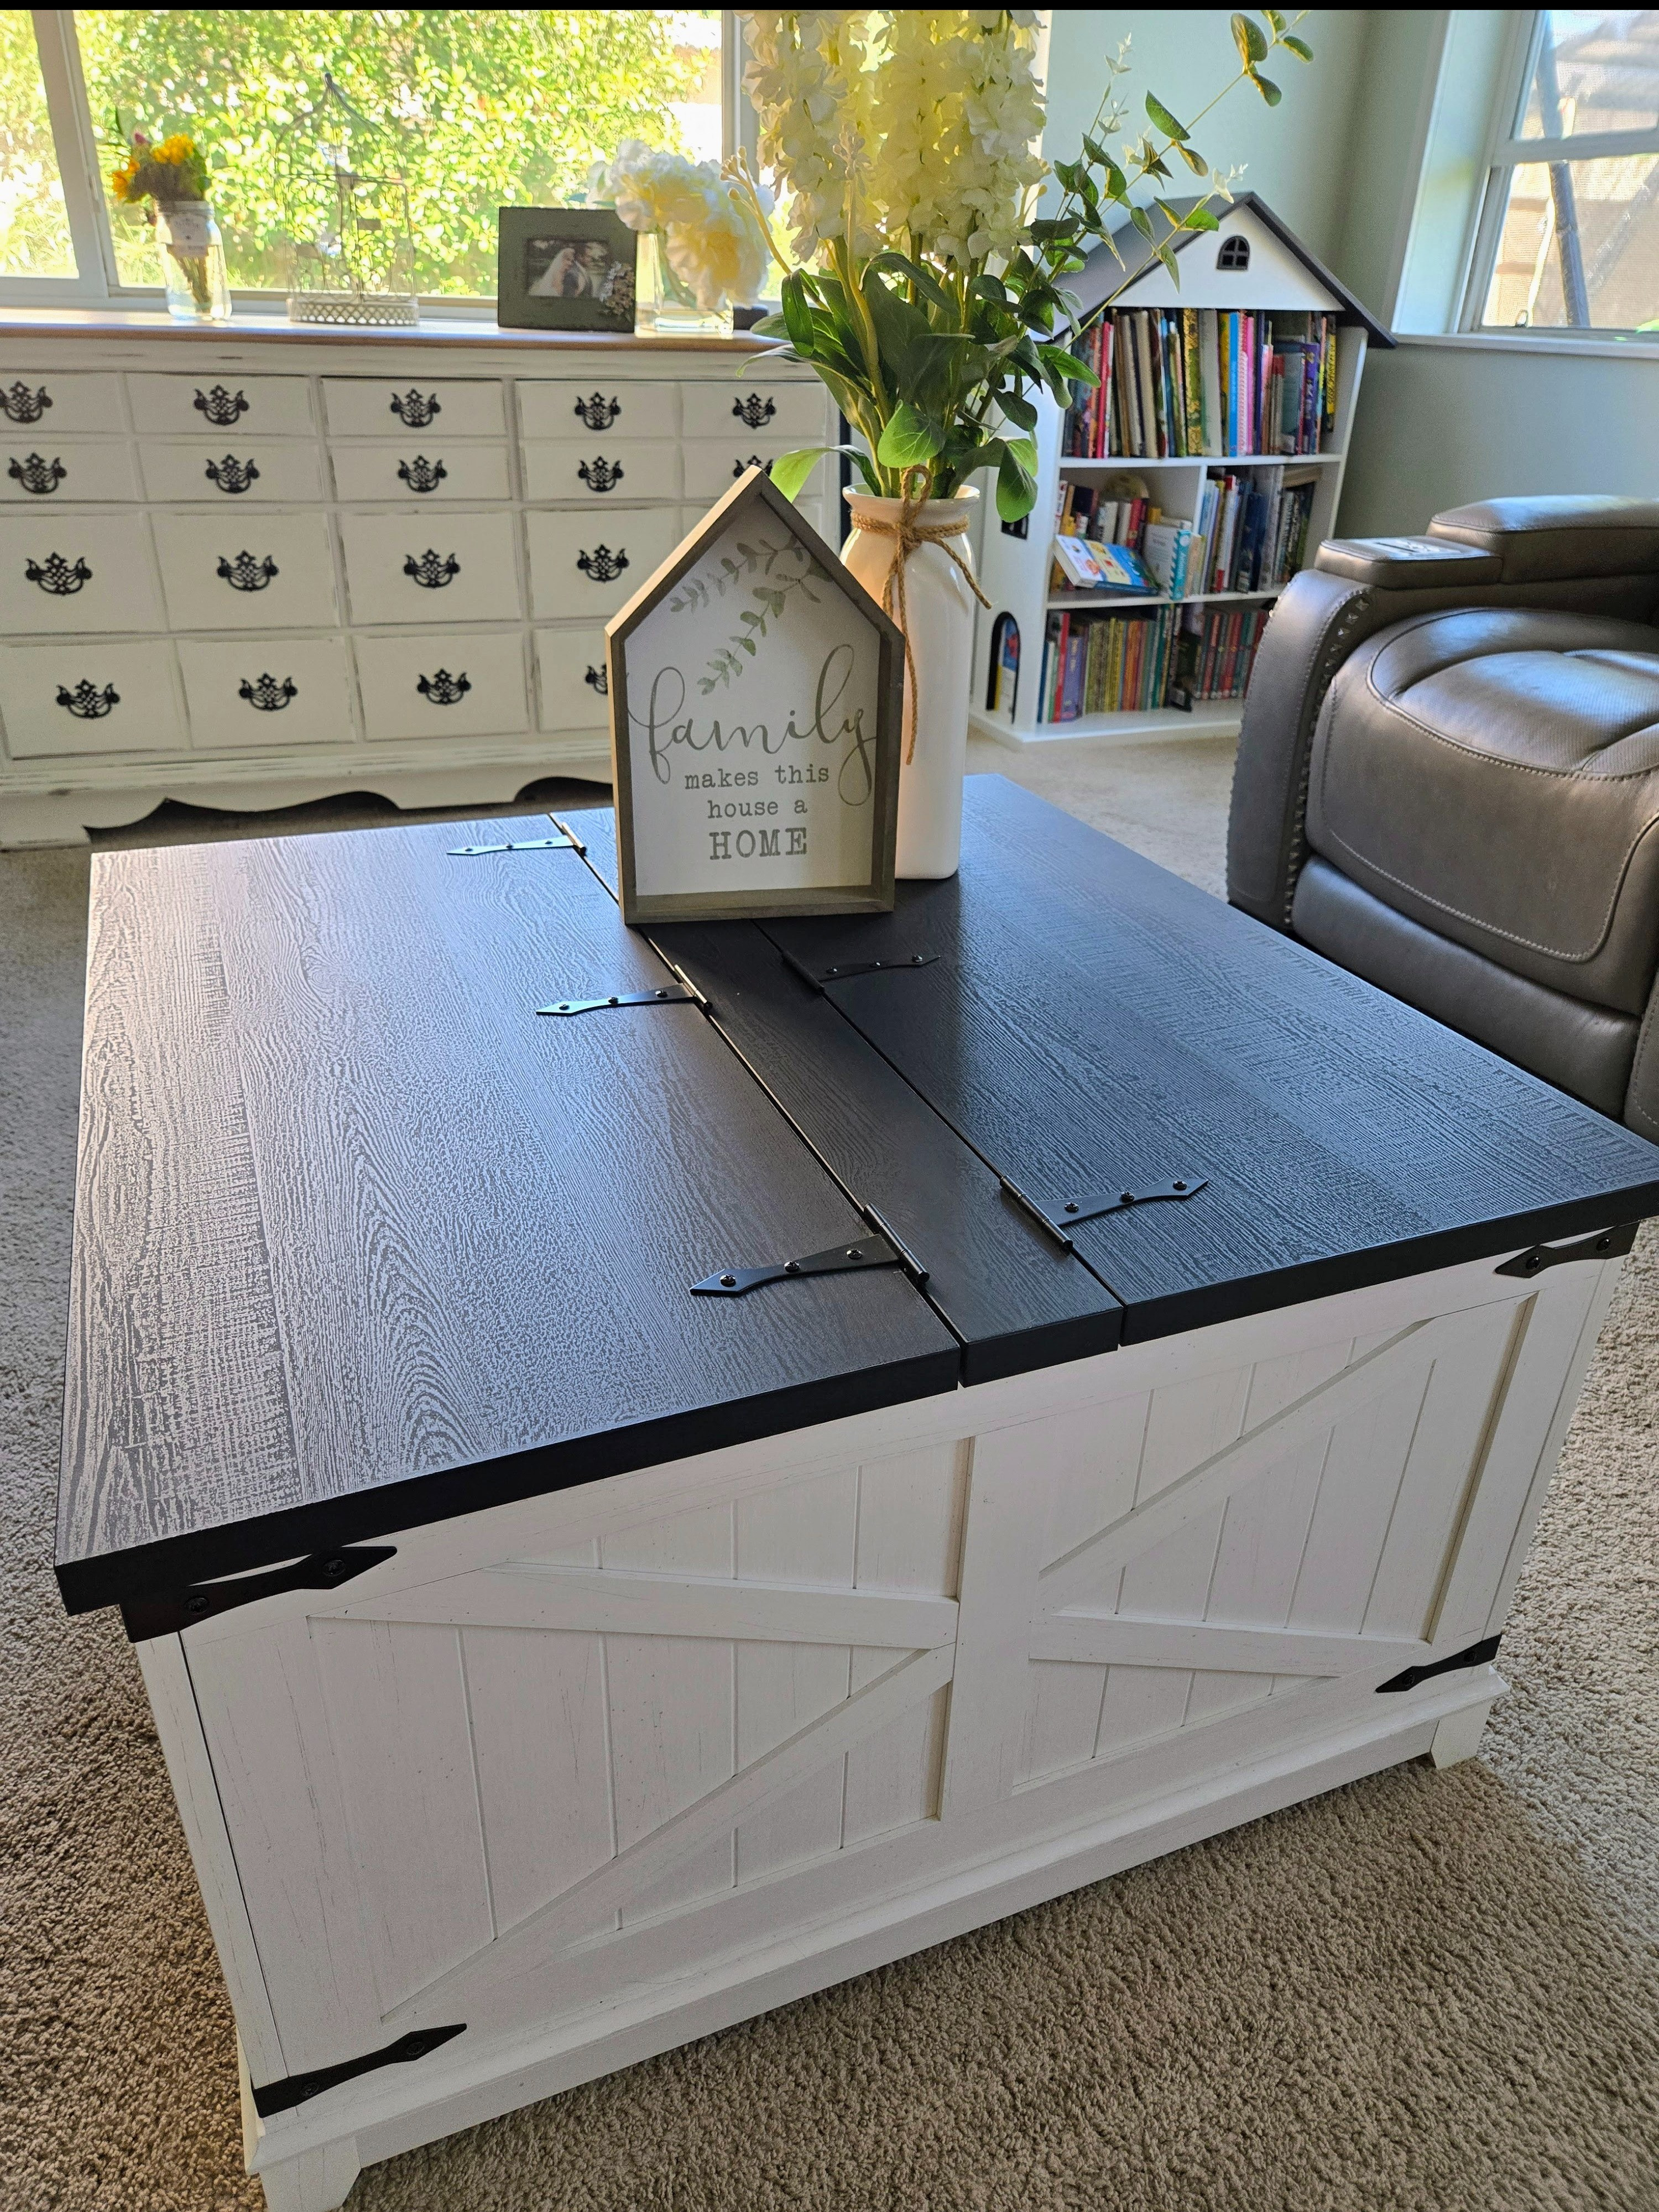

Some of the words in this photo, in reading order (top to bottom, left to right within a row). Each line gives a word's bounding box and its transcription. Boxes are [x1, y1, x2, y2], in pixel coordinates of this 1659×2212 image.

[628, 644, 877, 806] family
[685, 769, 759, 790] makes
[775, 764, 830, 784] this
[707, 800, 779, 818] house
[794, 800, 808, 815] a
[709, 827, 807, 860] HOME
